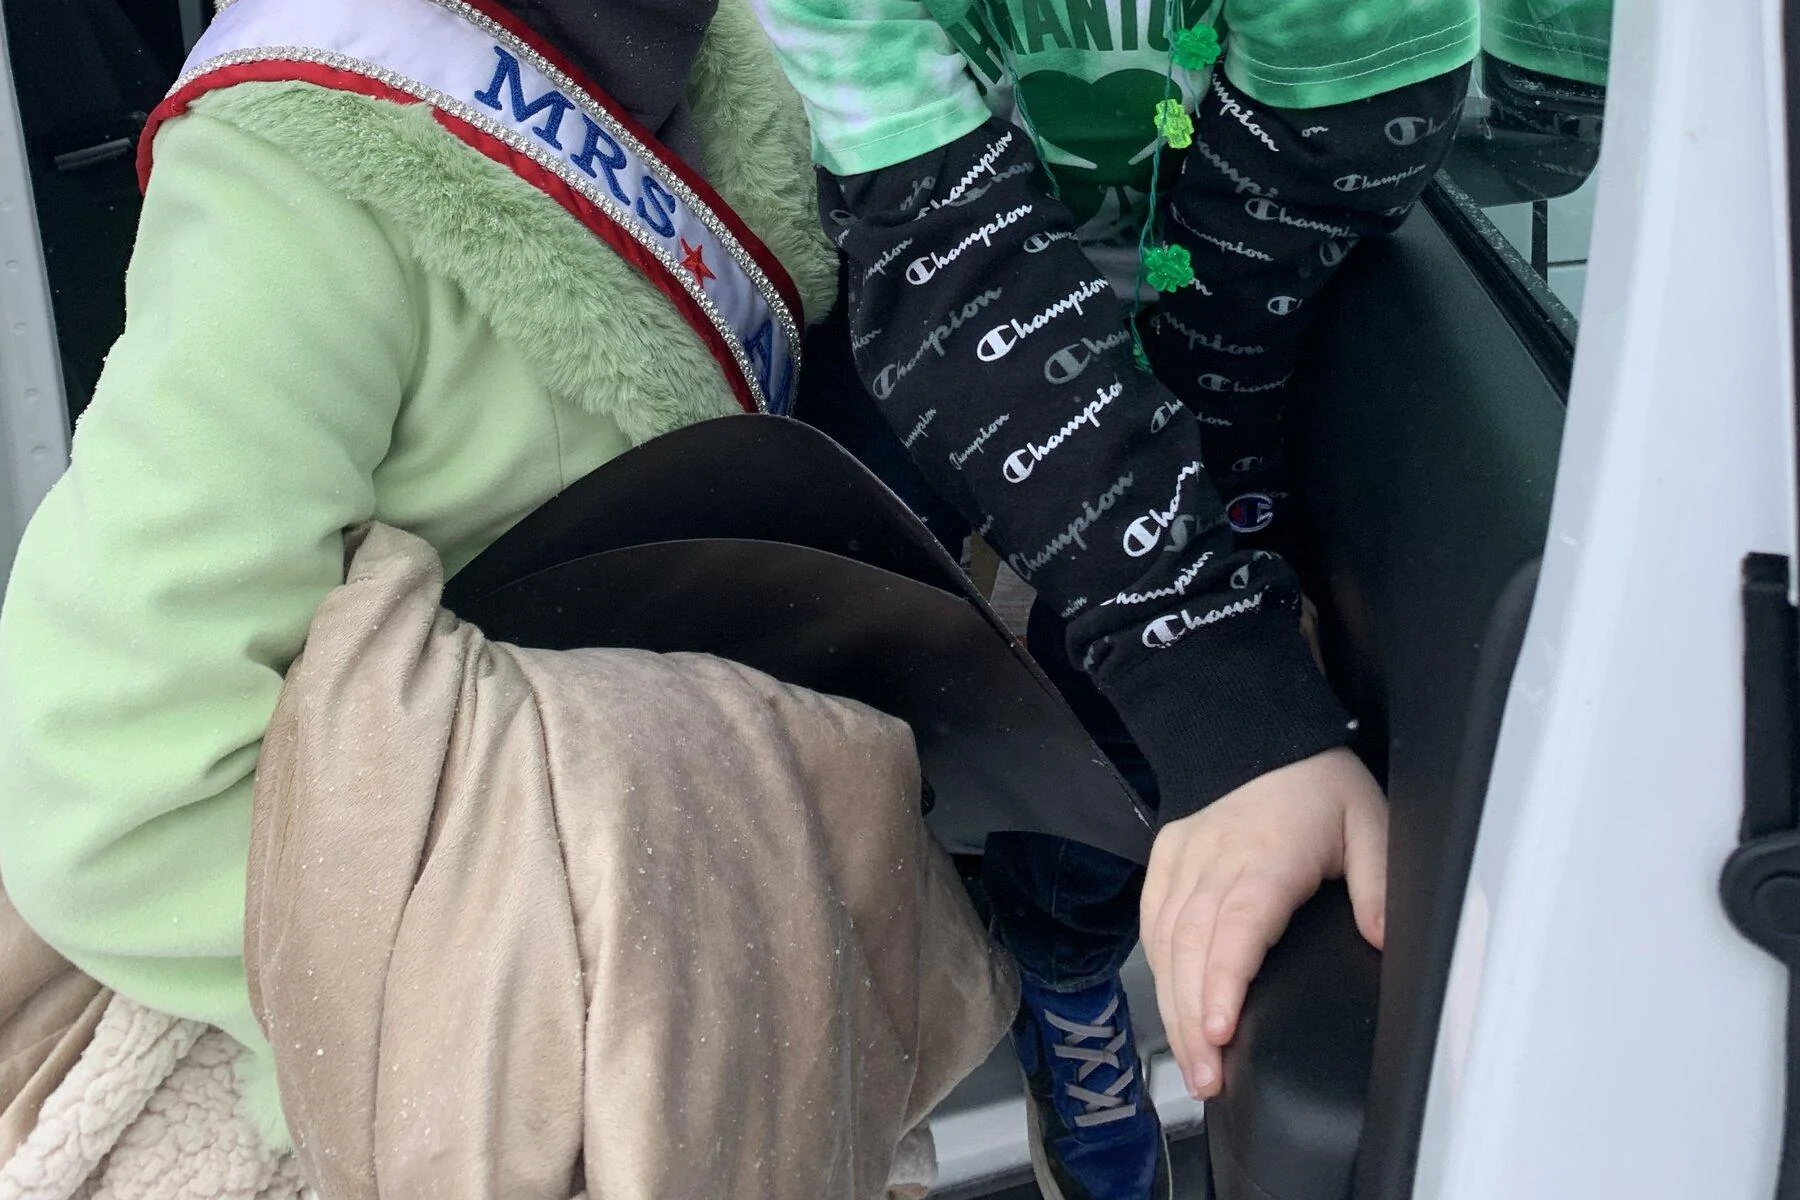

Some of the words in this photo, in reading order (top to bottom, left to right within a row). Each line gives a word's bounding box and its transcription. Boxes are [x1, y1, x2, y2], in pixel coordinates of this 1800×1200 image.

[474, 46, 676, 237] MRS
[905, 204, 1033, 286] Champion
[872, 287, 1002, 400] Champion
[976, 277, 1109, 362] Champion
[1002, 374, 1123, 483] Champio
[1008, 470, 1134, 582] Champion
